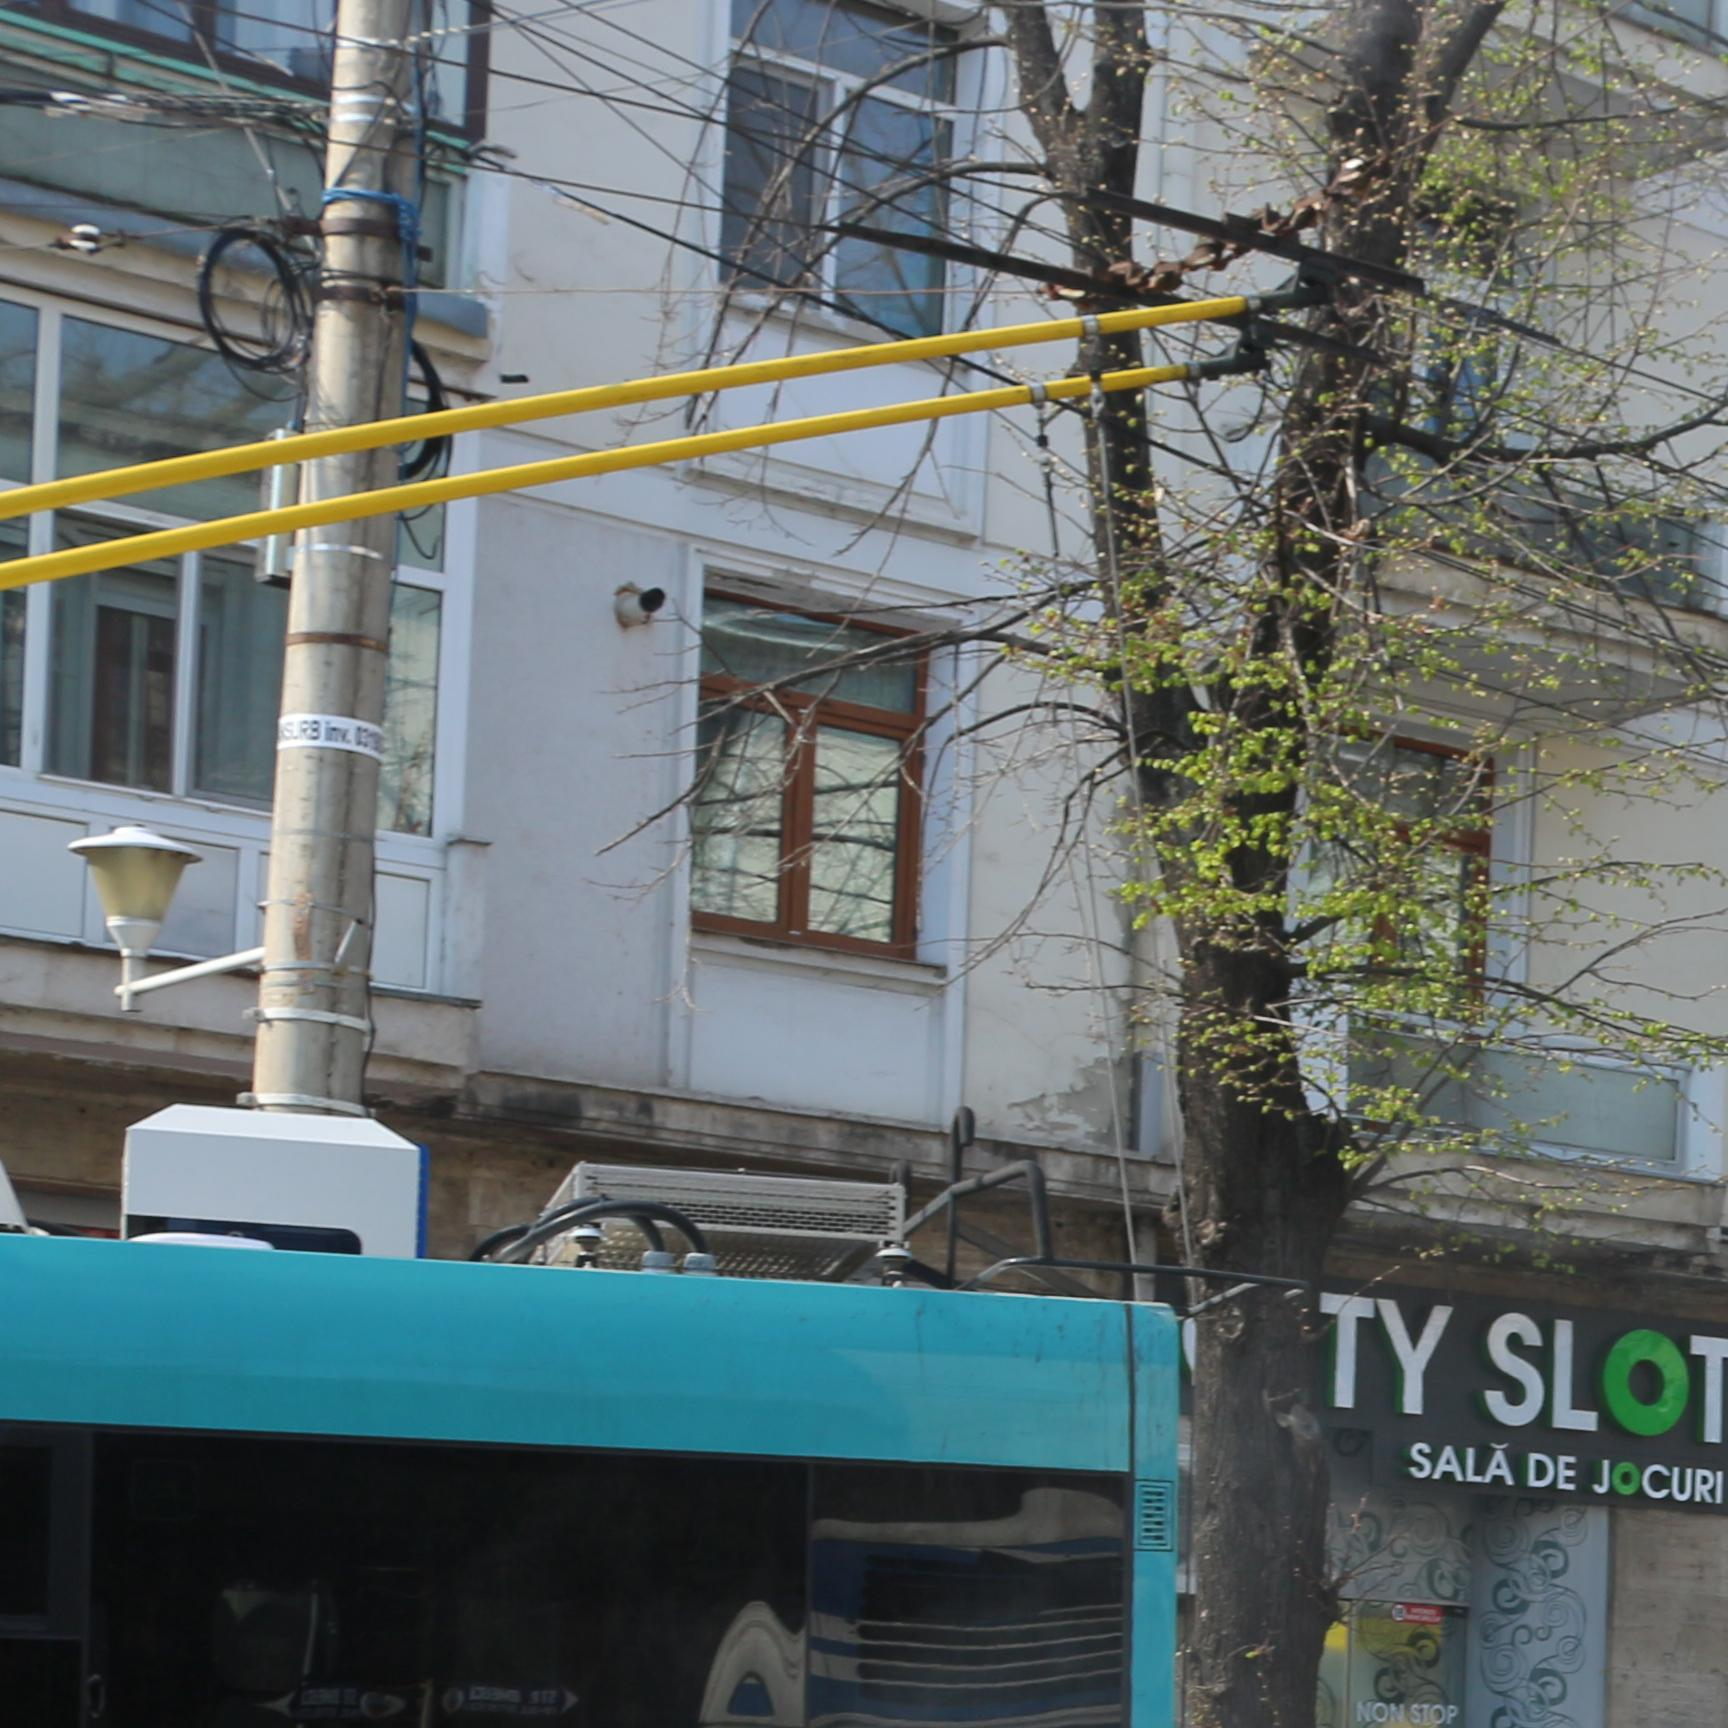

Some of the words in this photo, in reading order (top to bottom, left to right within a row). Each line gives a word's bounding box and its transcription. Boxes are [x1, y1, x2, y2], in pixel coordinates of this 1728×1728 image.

[1408, 1442, 1514, 1486] SALĂ
[1526, 1453, 1577, 1491] DE
[1592, 1460, 1724, 1505] JOCURI
[1356, 1701, 1404, 1722] NON
[1410, 1702, 1459, 1724] STOP
